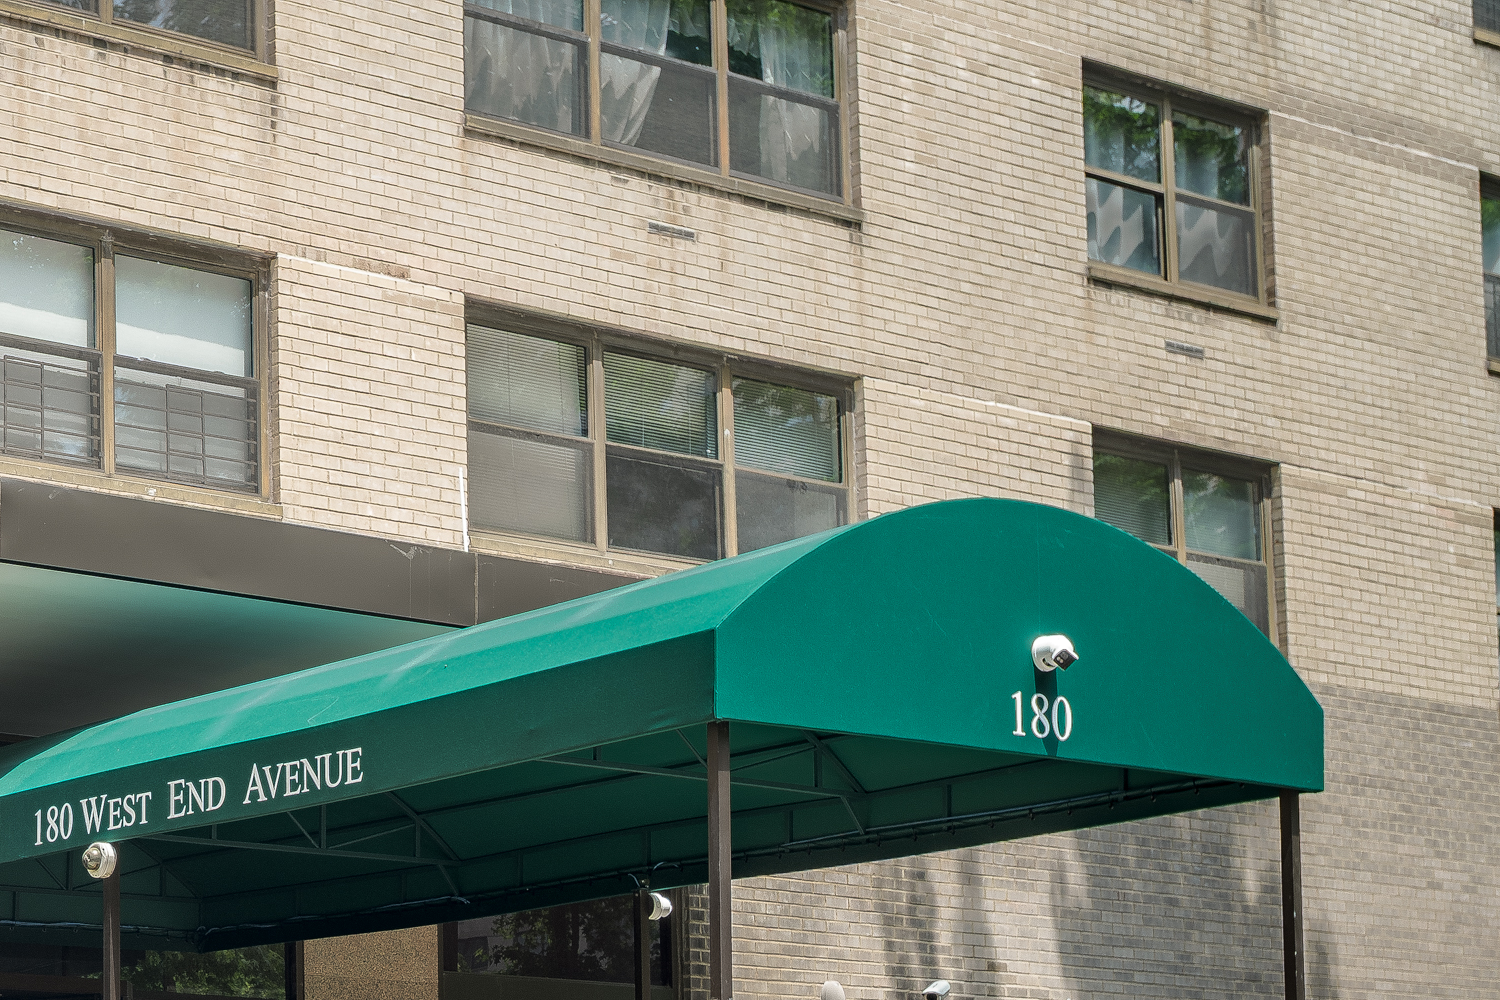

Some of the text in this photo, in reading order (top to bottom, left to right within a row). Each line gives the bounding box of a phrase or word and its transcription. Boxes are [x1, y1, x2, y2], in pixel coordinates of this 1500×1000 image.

[1011, 690, 1073, 742] 180
[34, 747, 363, 846] 180 WEST END AVENUE
